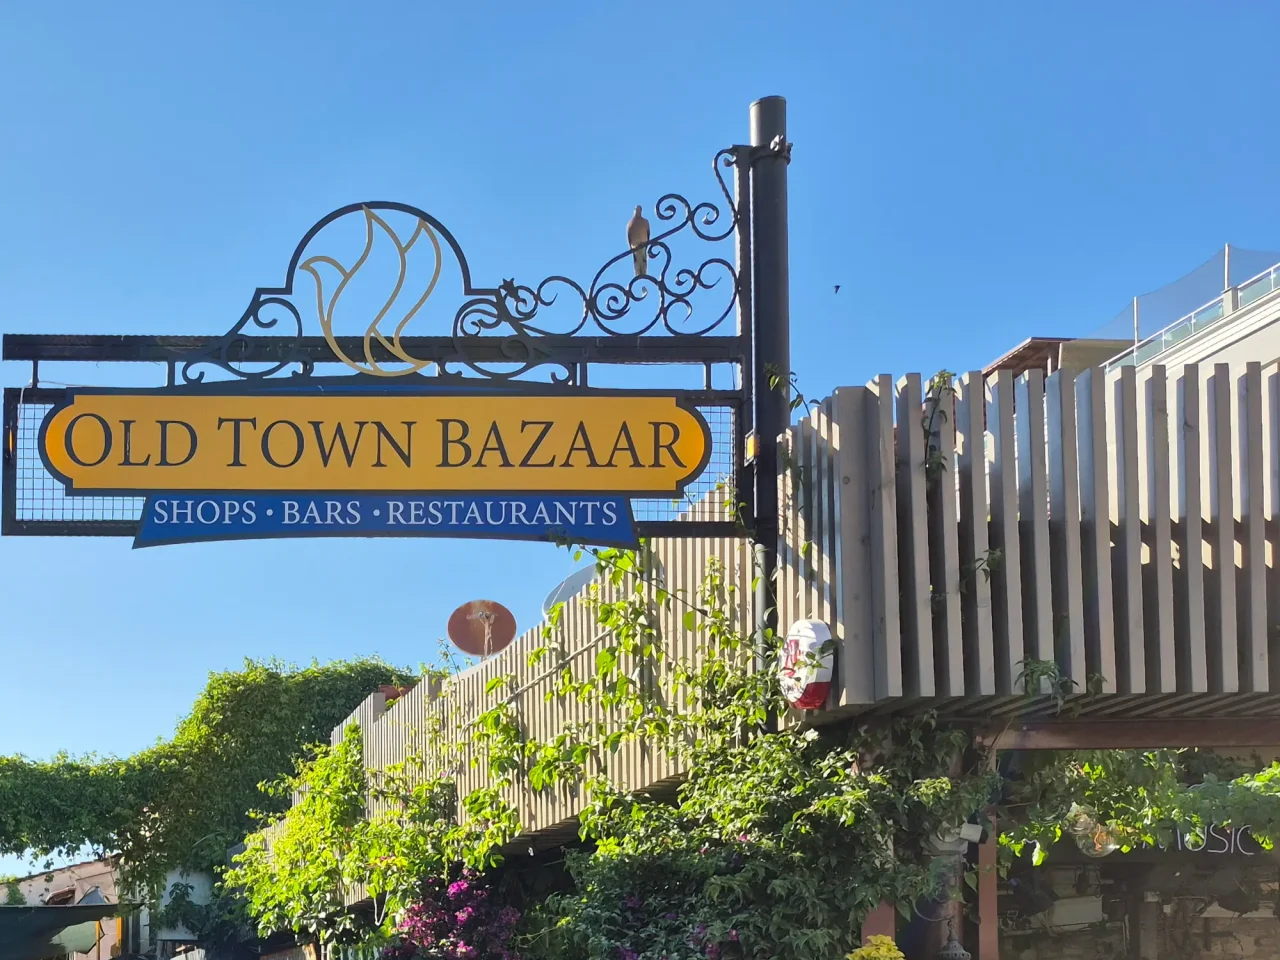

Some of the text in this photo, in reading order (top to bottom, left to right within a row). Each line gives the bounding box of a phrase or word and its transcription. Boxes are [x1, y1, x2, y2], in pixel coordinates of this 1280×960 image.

[63, 413, 688, 469] OLD TOWN BAZAAR
[154, 499, 617, 526] SHOPS BARS RESTAURANTS
[1176, 822, 1255, 855] USIC
